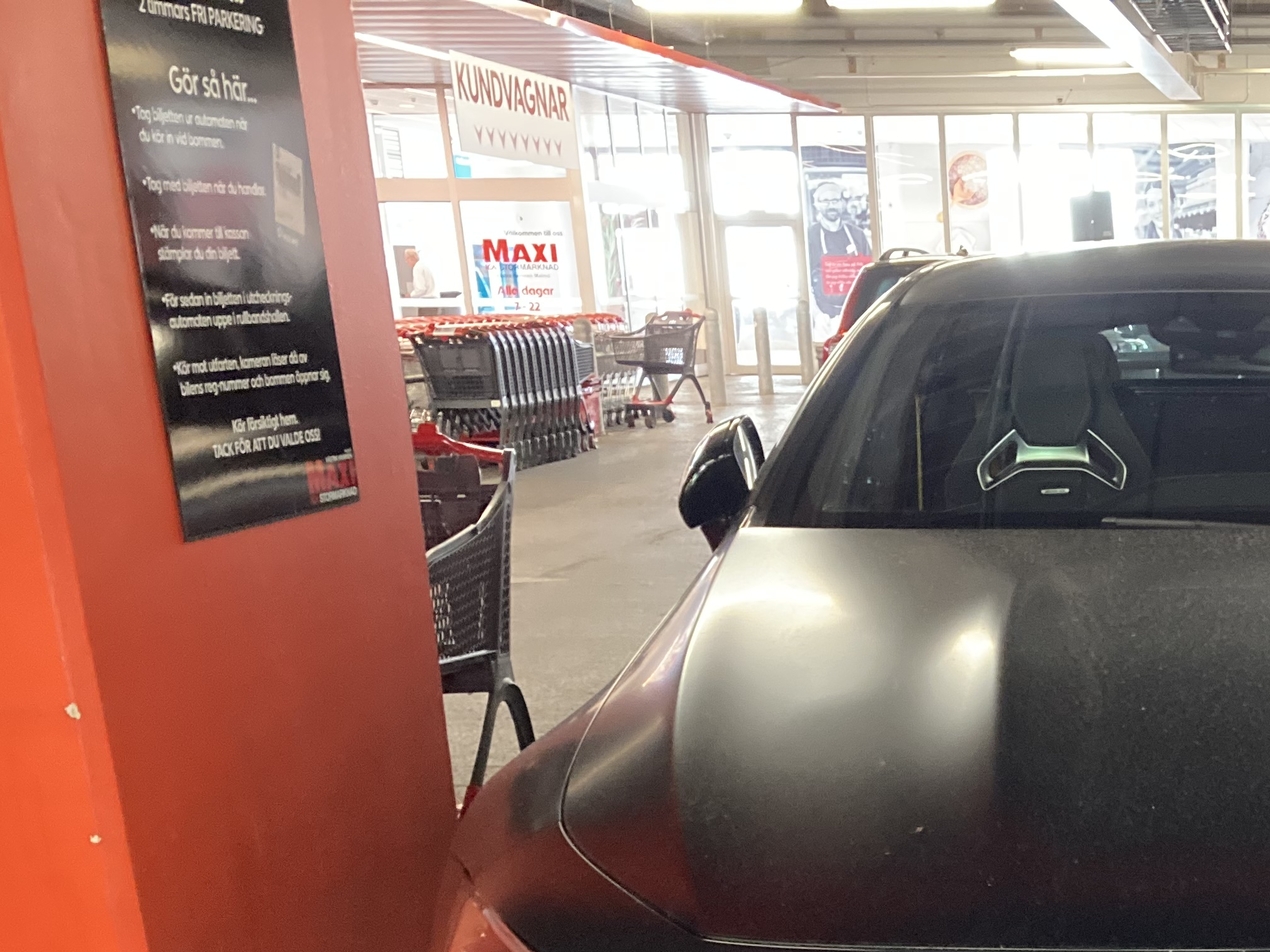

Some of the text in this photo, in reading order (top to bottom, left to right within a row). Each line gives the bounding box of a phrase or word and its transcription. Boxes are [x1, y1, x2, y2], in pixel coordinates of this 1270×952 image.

[190, 3, 208, 25] FRI
[208, 7, 265, 35] PARKERING
[169, 65, 257, 103] Gör så här...
[454, 61, 570, 122] KUNDVAGNAR
[135, 105, 151, 124] Tag
[195, 114, 235, 129] automaten
[235, 117, 247, 131] när
[139, 127, 150, 142] du
[146, 176, 162, 196] Tag
[163, 179, 181, 192] med
[213, 180, 226, 194] när
[228, 181, 237, 195] du
[153, 224, 169, 239] När
[171, 224, 181, 239] du
[182, 225, 213, 239] kommer
[194, 246, 204, 261] du
[180, 291, 204, 307] sedan
[204, 291, 213, 306] in
[498, 284, 554, 298] Alla dagar
[529, 302, 541, 311] 22
[169, 314, 212, 329] automaten
[213, 314, 232, 329] uppe
[176, 360, 191, 375] Kör
[191, 359, 208, 374] mot
[239, 355, 271, 370] kameran
[298, 352, 308, 364] av
[179, 380, 204, 397] bilens
[204, 377, 250, 396] reg-nummer
[251, 374, 265, 388] och
[264, 372, 295, 387] bommen
[231, 418, 246, 434] Kör
[212, 443, 235, 459] TACK
[234, 437, 251, 455] FÖR
[252, 437, 268, 452] ATT
[267, 434, 280, 450] DU
[279, 431, 305, 446] VALDE
